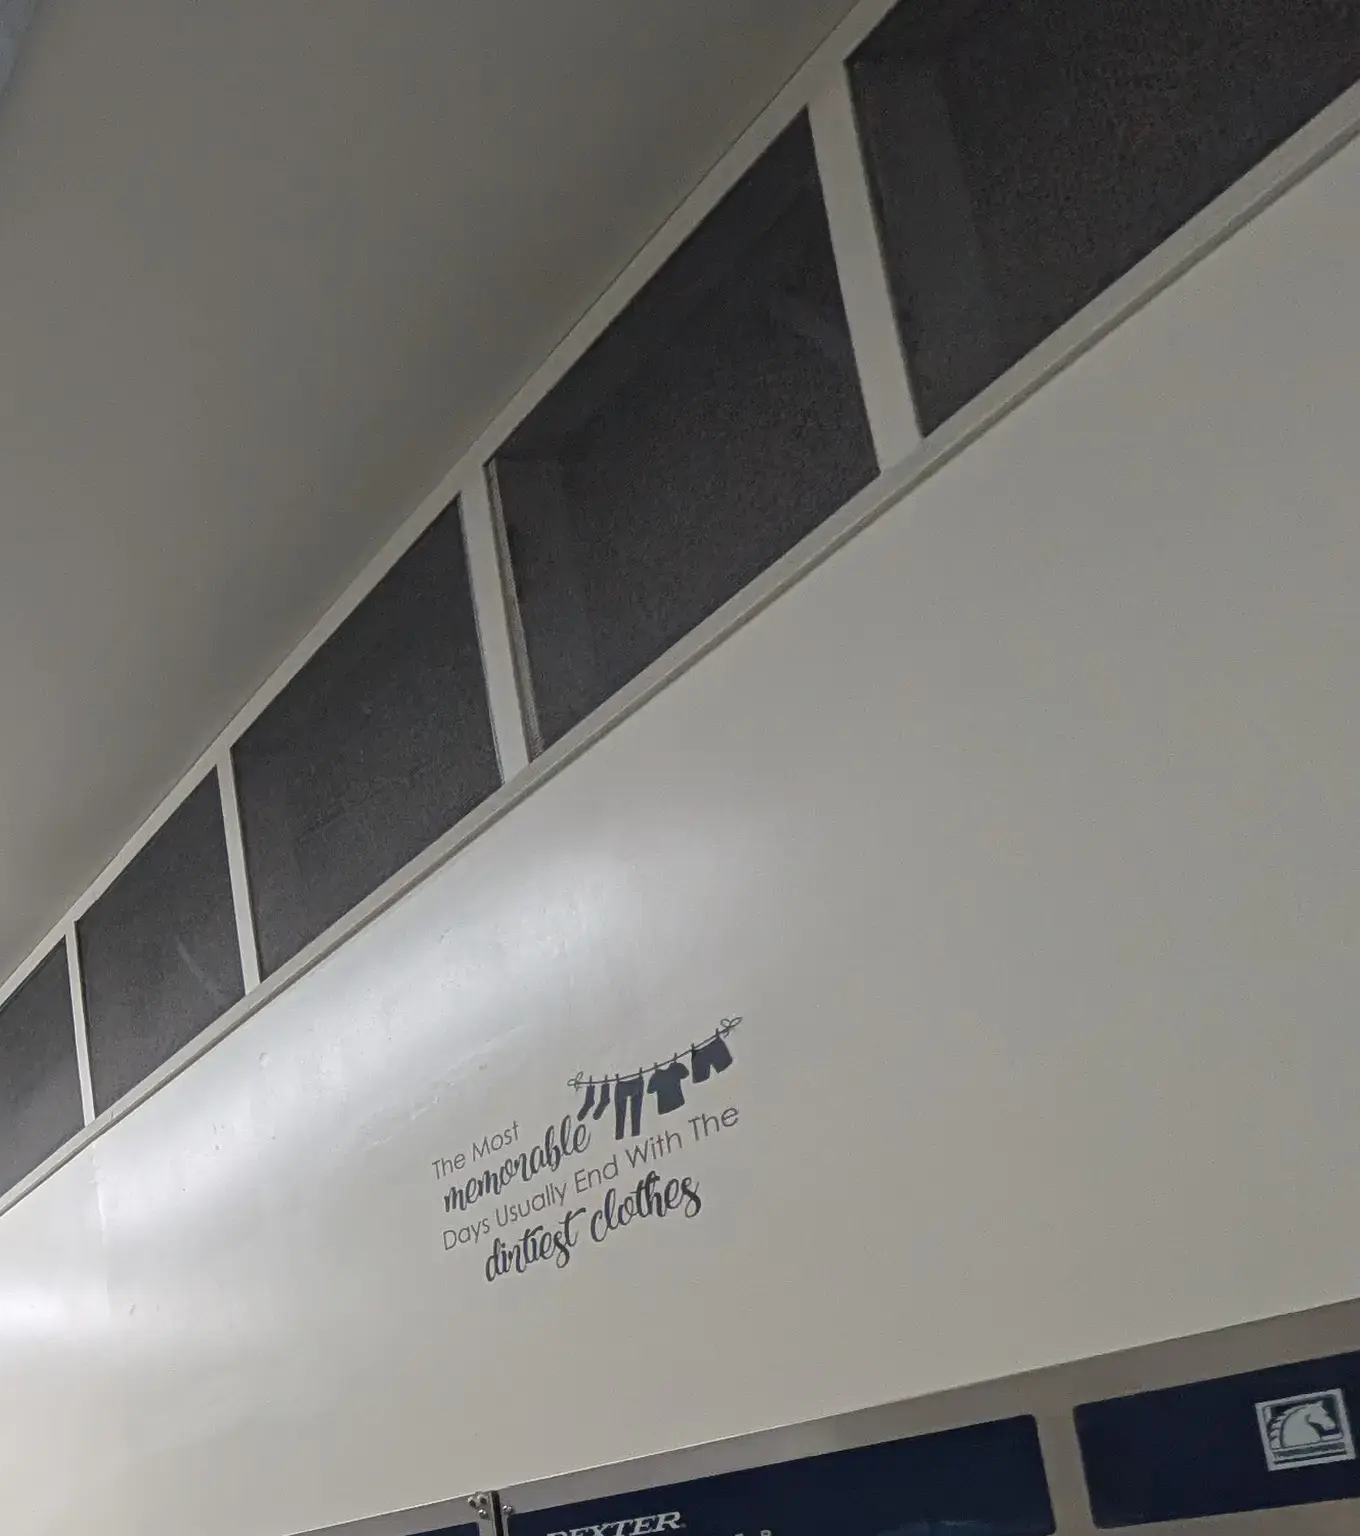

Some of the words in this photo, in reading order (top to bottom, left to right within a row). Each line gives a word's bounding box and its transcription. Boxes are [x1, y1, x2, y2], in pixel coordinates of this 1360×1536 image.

[431, 1149, 467, 1180] The
[471, 1120, 520, 1162] Most
[442, 1217, 491, 1251] Days
[495, 1181, 568, 1229] Usually
[573, 1154, 619, 1193] End
[625, 1128, 682, 1170] With
[687, 1105, 740, 1142] The
[443, 1115, 591, 1213] memorable
[484, 1207, 587, 1282] dirtiest
[590, 1170, 703, 1243] clothes
